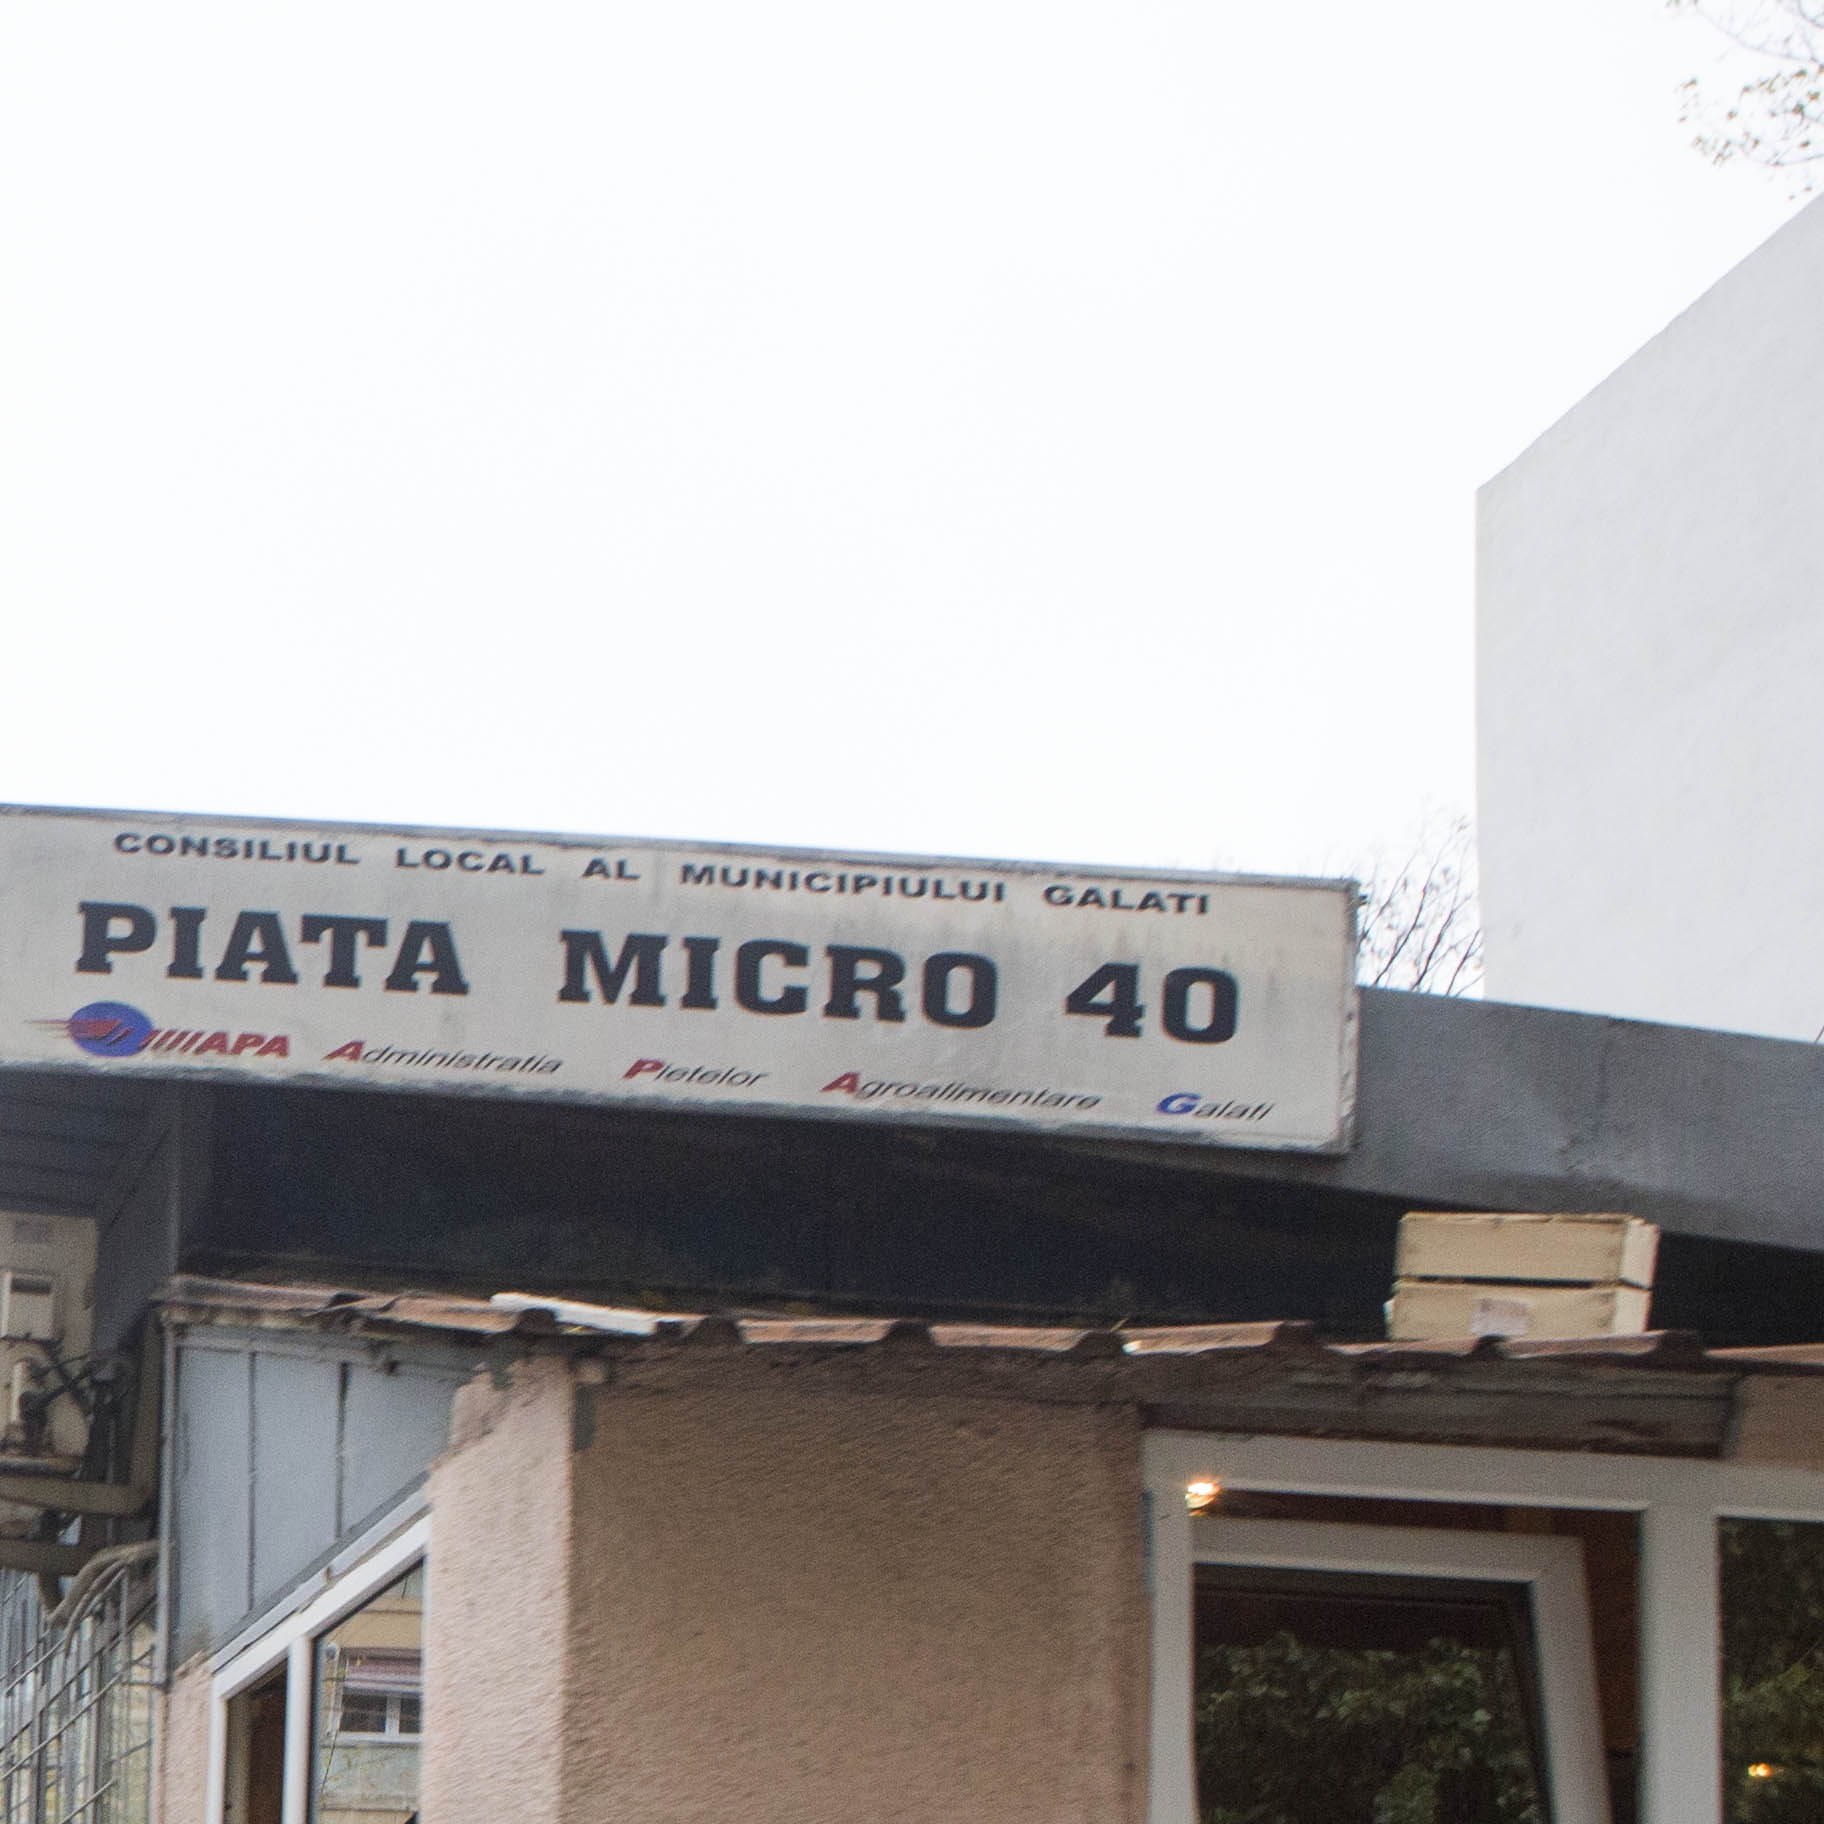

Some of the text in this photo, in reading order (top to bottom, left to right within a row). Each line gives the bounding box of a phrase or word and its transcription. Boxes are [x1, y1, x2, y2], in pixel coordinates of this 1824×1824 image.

[113, 832, 1211, 914] CONSILIUL LOCAL AL MUNICIPIULUI GALATI
[75, 900, 1240, 1044] PIATA MICRO 40
[1156, 1093, 1275, 1122] Galati
